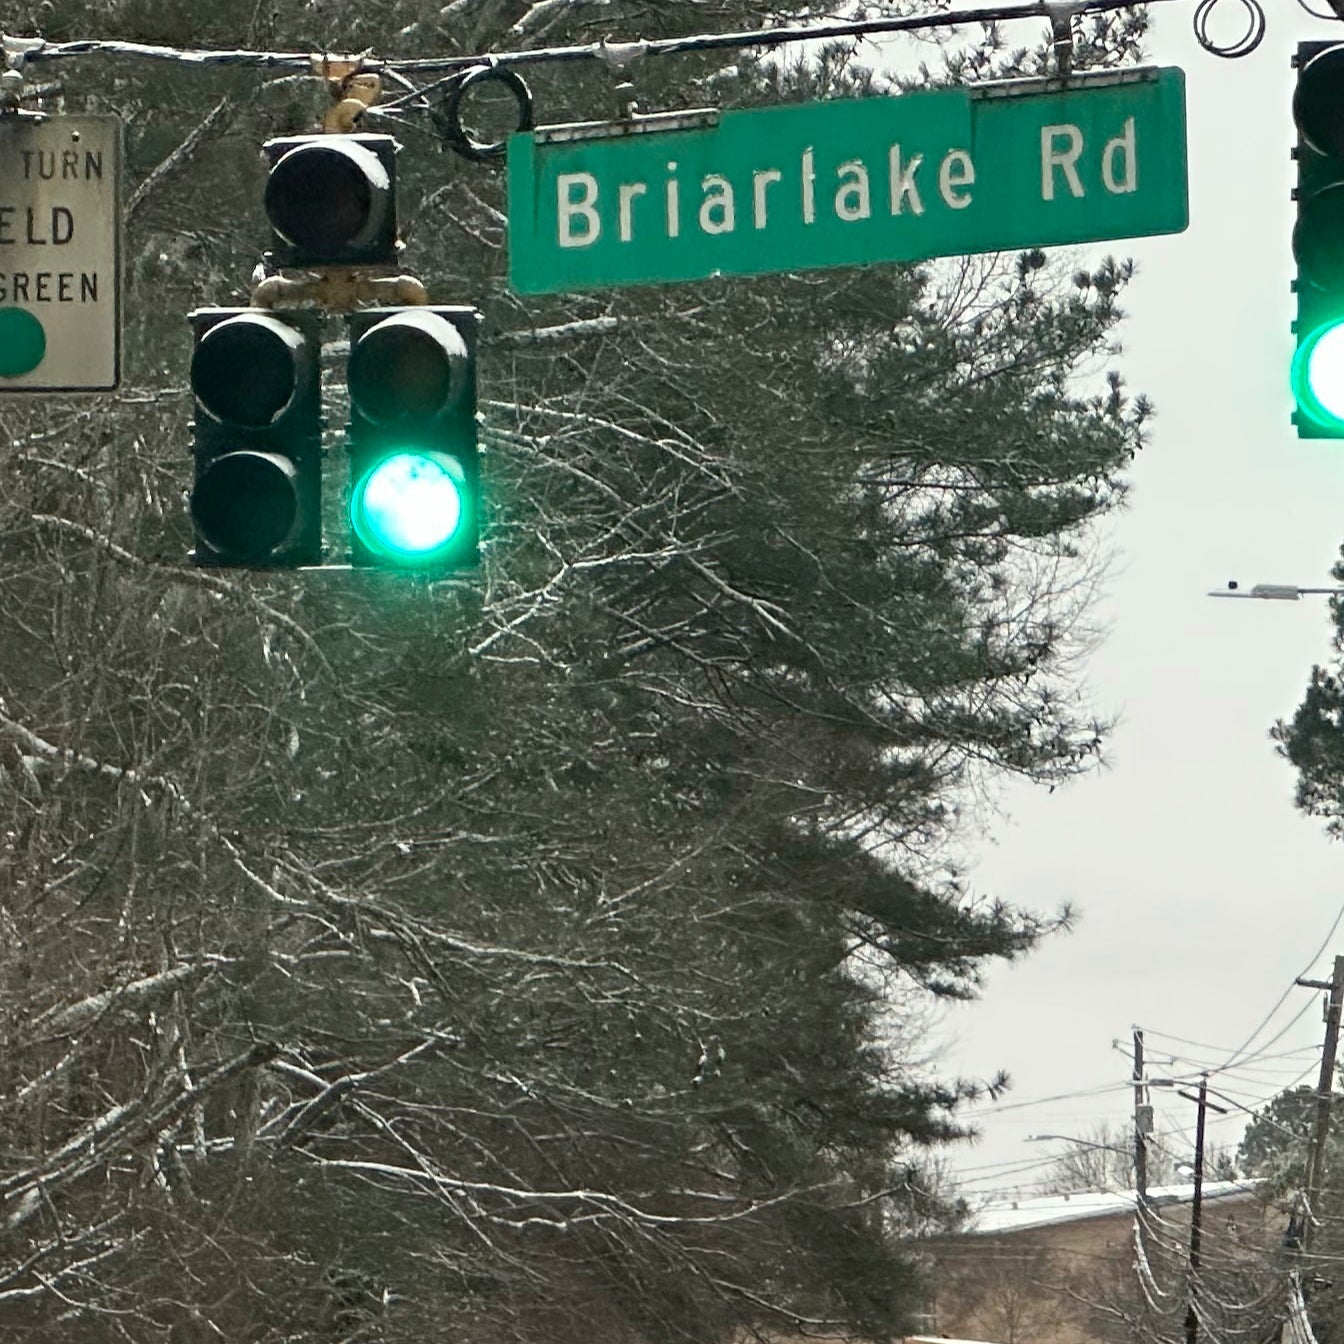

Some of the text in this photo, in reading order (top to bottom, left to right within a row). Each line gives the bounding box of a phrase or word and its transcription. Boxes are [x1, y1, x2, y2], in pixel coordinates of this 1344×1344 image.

[19, 151, 103, 180] TURN
[557, 116, 1137, 248] Briarlake Rd
